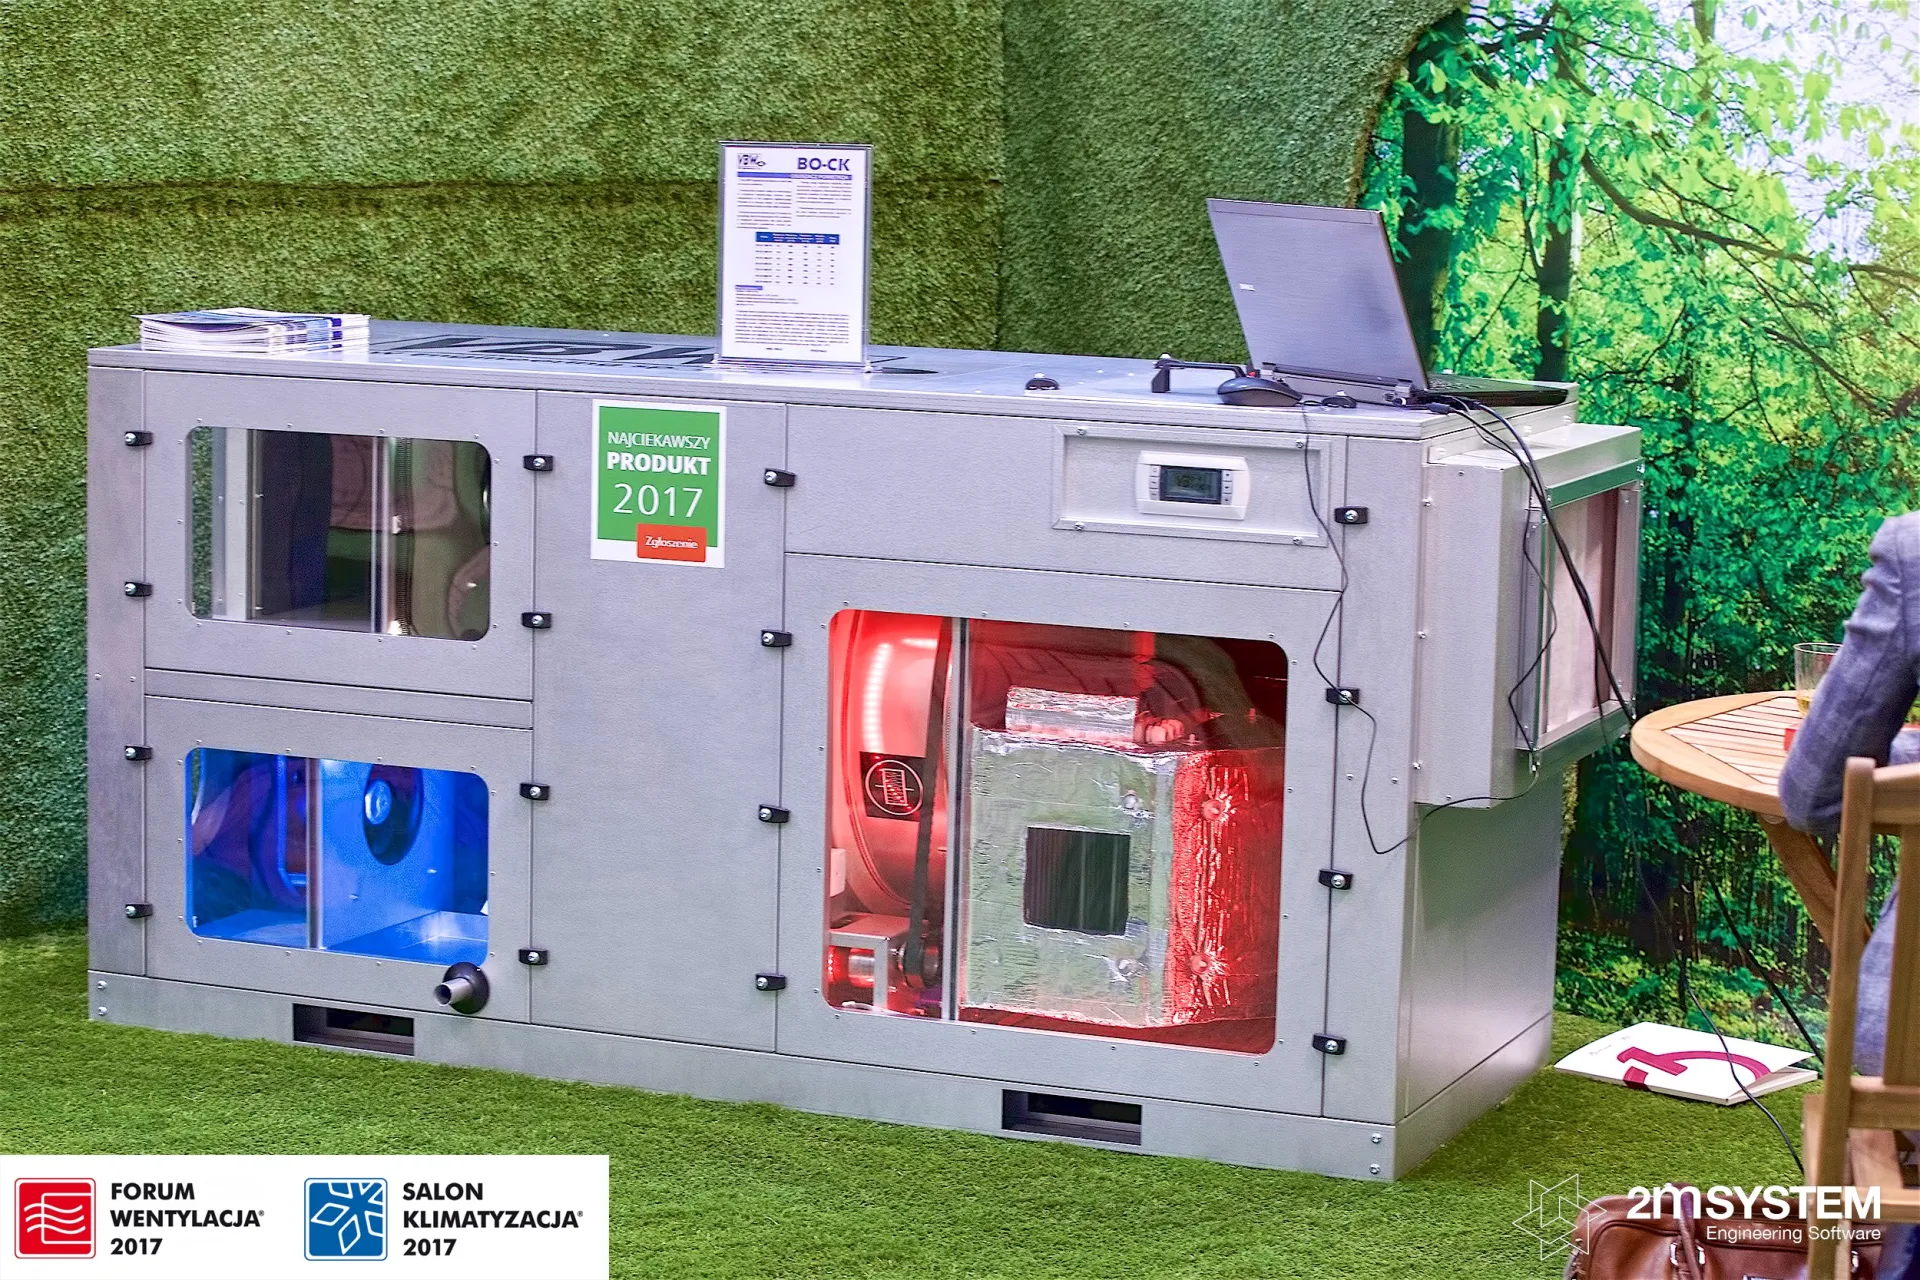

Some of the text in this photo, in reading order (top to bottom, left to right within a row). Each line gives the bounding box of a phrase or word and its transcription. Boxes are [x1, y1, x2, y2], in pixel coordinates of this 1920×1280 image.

[797, 157, 851, 171] BO-CK
[607, 431, 711, 449] NAJCIEKAWSZY
[606, 451, 712, 476] PRODUKT
[612, 482, 704, 518] 2017
[644, 535, 699, 549] Zgłoszenie
